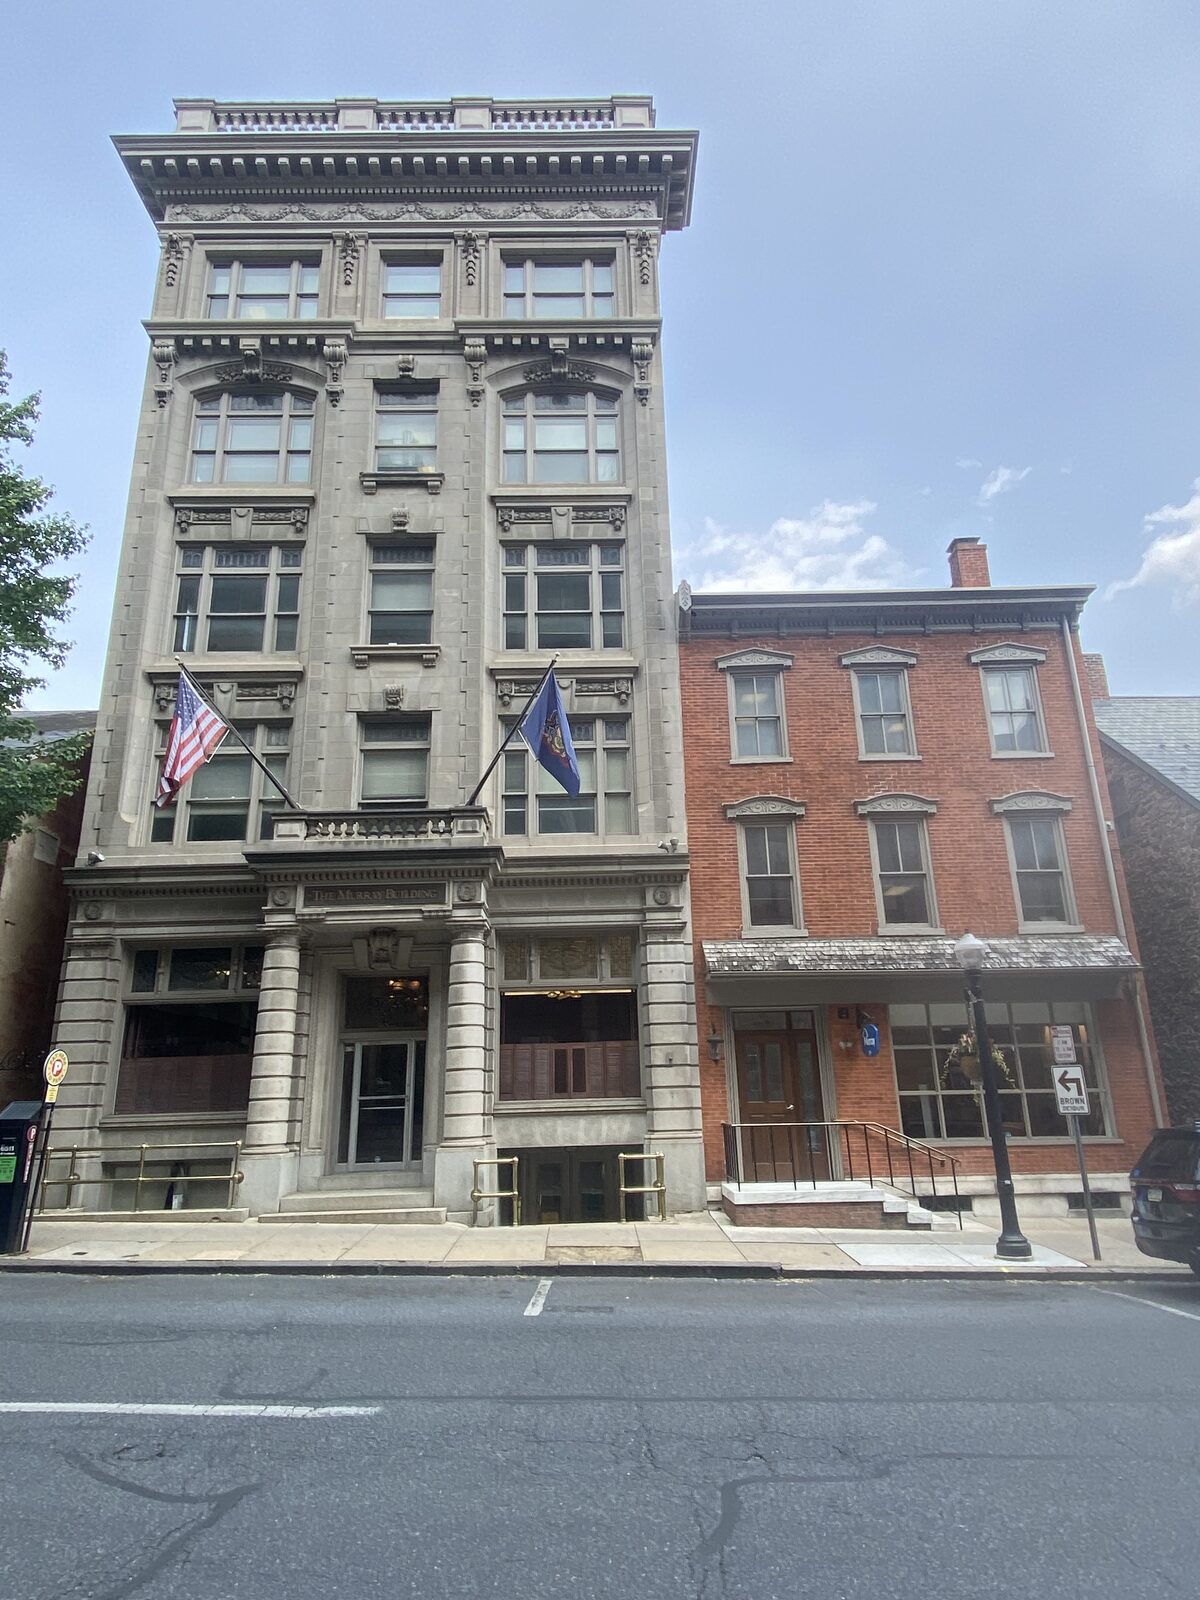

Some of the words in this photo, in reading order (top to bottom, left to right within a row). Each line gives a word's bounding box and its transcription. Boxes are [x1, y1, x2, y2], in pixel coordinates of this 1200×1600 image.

[312, 890, 336, 901] THE
[337, 889, 383, 901] MURRAY
[384, 888, 437, 899] BUILDING
[53, 1060, 63, 1075] P
[1060, 1097, 1085, 1105] BROWN
[31, 1128, 36, 1139] P
